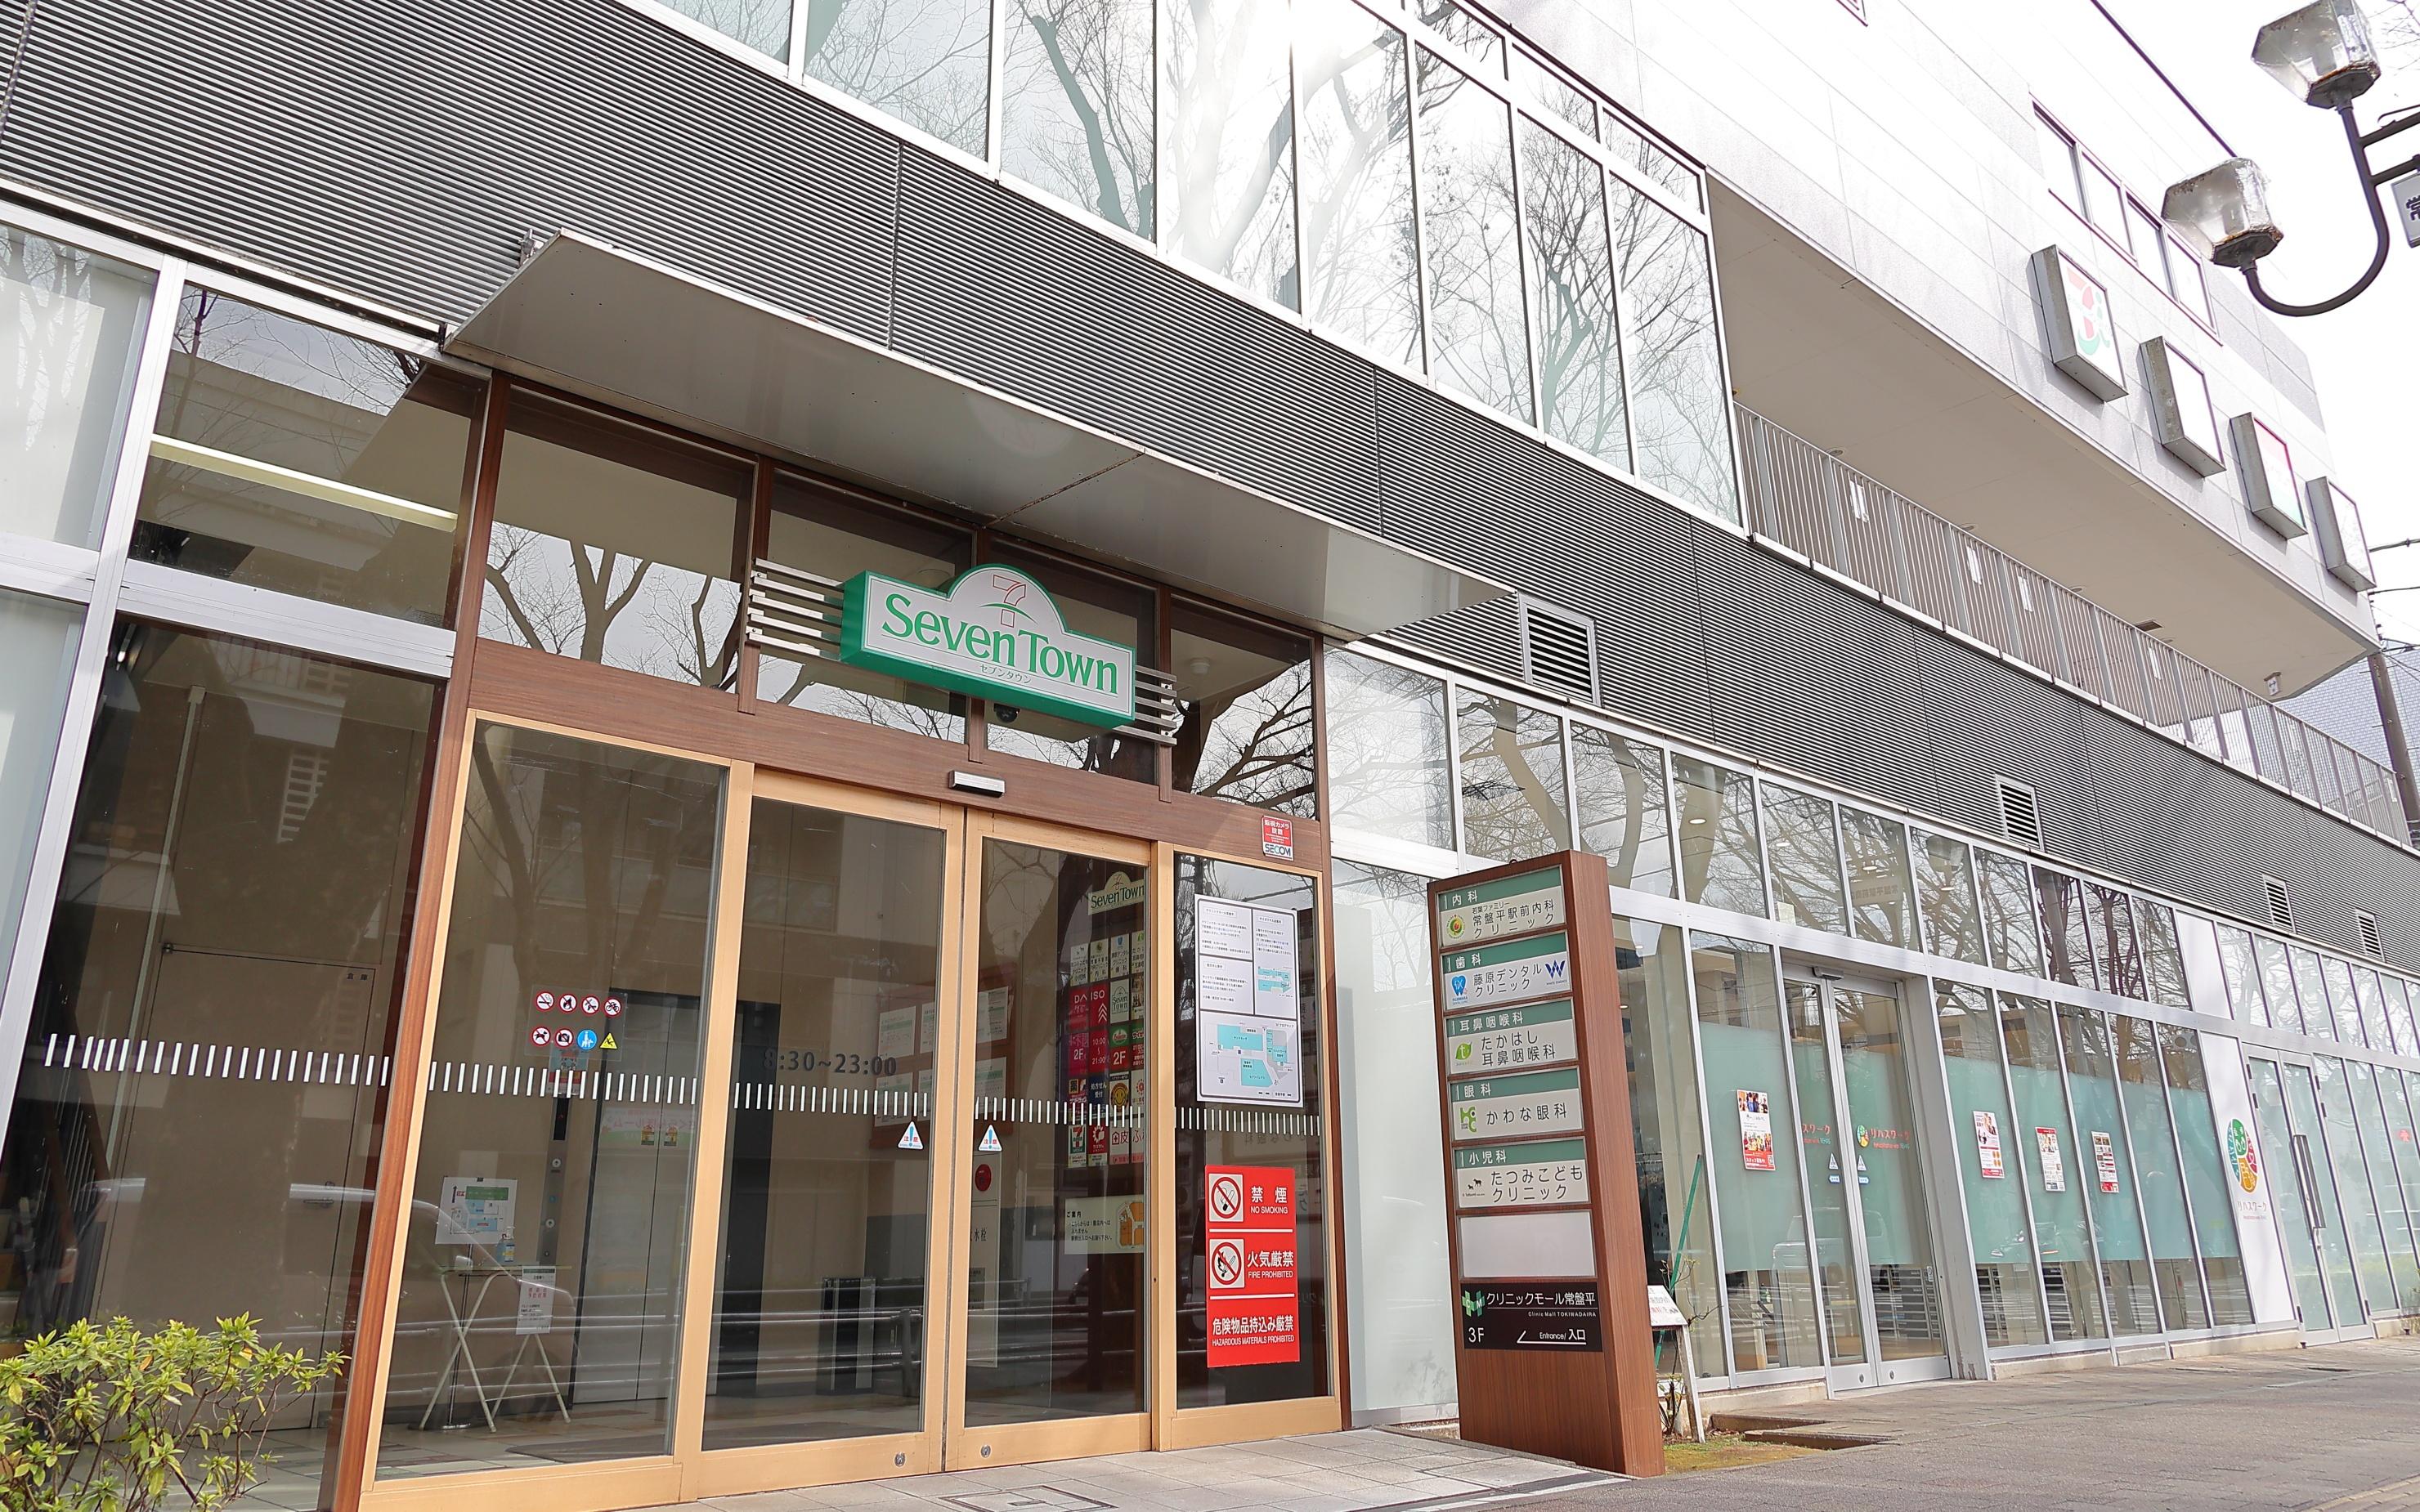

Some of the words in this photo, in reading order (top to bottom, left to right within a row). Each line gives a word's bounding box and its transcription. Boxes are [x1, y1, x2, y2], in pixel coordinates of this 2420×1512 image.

[979, 663, 1032, 684] セブンタウン
[1265, 843, 1291, 857] SECOM
[1452, 889, 1478, 906] 内科
[1472, 901, 1510, 915] 若葉ファミリー
[1472, 899, 1554, 927] 常盤平駅前内科
[1474, 913, 1554, 939] クリニック
[1455, 953, 1481, 969] 歯科
[1473, 963, 1542, 986] 藤原デンタル
[1475, 978, 1530, 998] クリニック
[1459, 1011, 1524, 1032] 耳鼻咽喉科
[1481, 1031, 1538, 1051] たかはし
[1113, 1050, 1127, 1065] 2F
[1481, 1044, 1556, 1067] 耳鼻咽喉科
[1463, 1083, 1491, 1098] 眼科
[1486, 1103, 1567, 1125] かわな眼科
[1469, 1149, 1507, 1165] 小児科
[1491, 1165, 1583, 1186] たつみこども
[1492, 1183, 1566, 1203] クリニック
[1250, 1206, 1260, 1214] NO
[1261, 1206, 1288, 1215] SMOKING
[1247, 1250, 1294, 1268] 火気厳禁
[1248, 1271, 1261, 1279] FIRE
[1262, 1270, 1293, 1278] PROHIBITED
[1486, 1291, 1596, 1306] クリニックモール常盤平
[1212, 1315, 1294, 1335] 危険物品持込み厳禁
[1212, 1336, 1242, 1346] HAZARDOUS
[1242, 1335, 1267, 1345] MATERIALS
[1267, 1334, 1295, 1344] PROHIBITED
[1468, 1326, 1485, 1343] 3F
[1568, 1329, 1586, 1340] 入口
